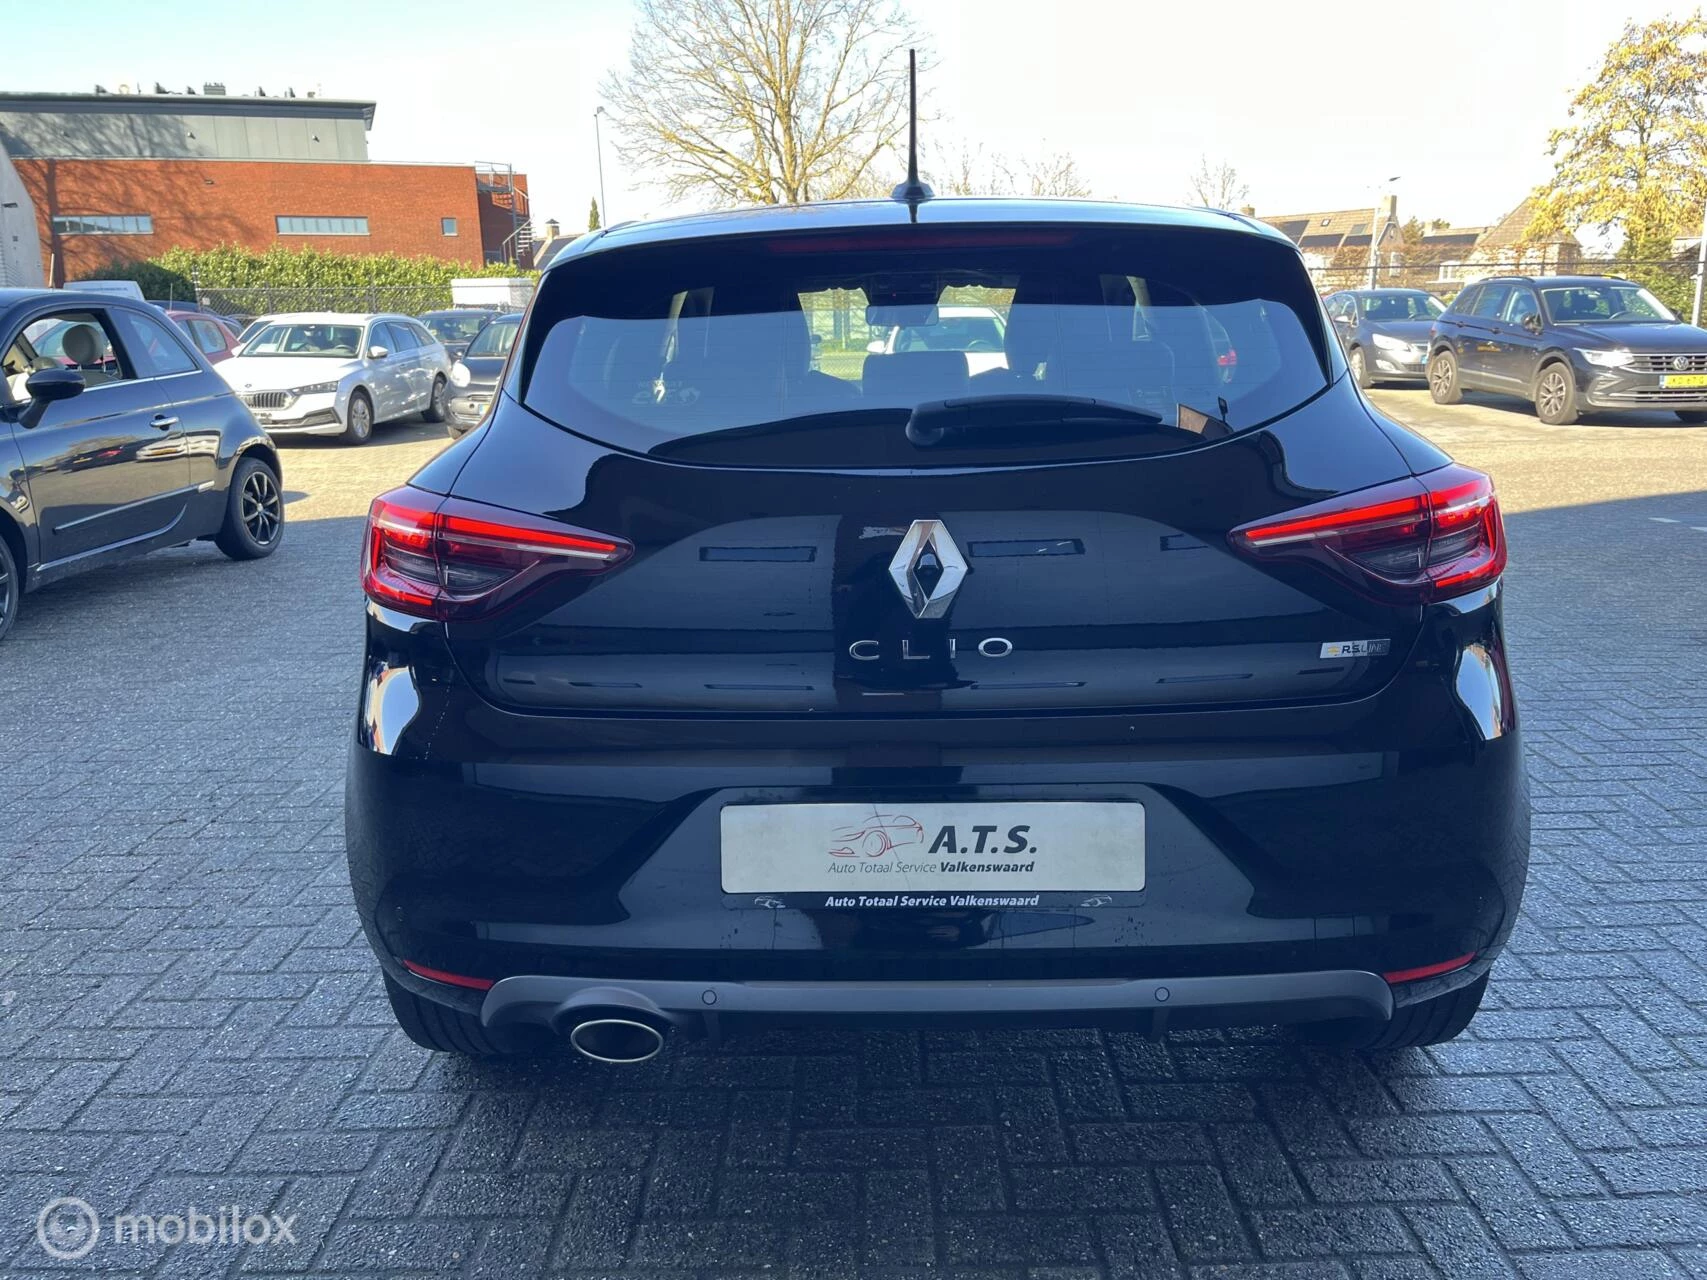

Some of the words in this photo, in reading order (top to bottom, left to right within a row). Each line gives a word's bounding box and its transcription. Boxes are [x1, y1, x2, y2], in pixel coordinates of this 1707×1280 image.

[849, 637, 1013, 660] CLIO
[928, 825, 1037, 854] A.T.S.
[828, 862, 856, 873] Auto
[859, 861, 893, 873] Totaal
[895, 861, 937, 873] Service
[940, 861, 1035, 873] Valkenswaard
[825, 896, 856, 907] Auto
[859, 896, 898, 907] Totaal
[900, 896, 947, 907] Service
[950, 895, 1040, 907] Valkenswaard
